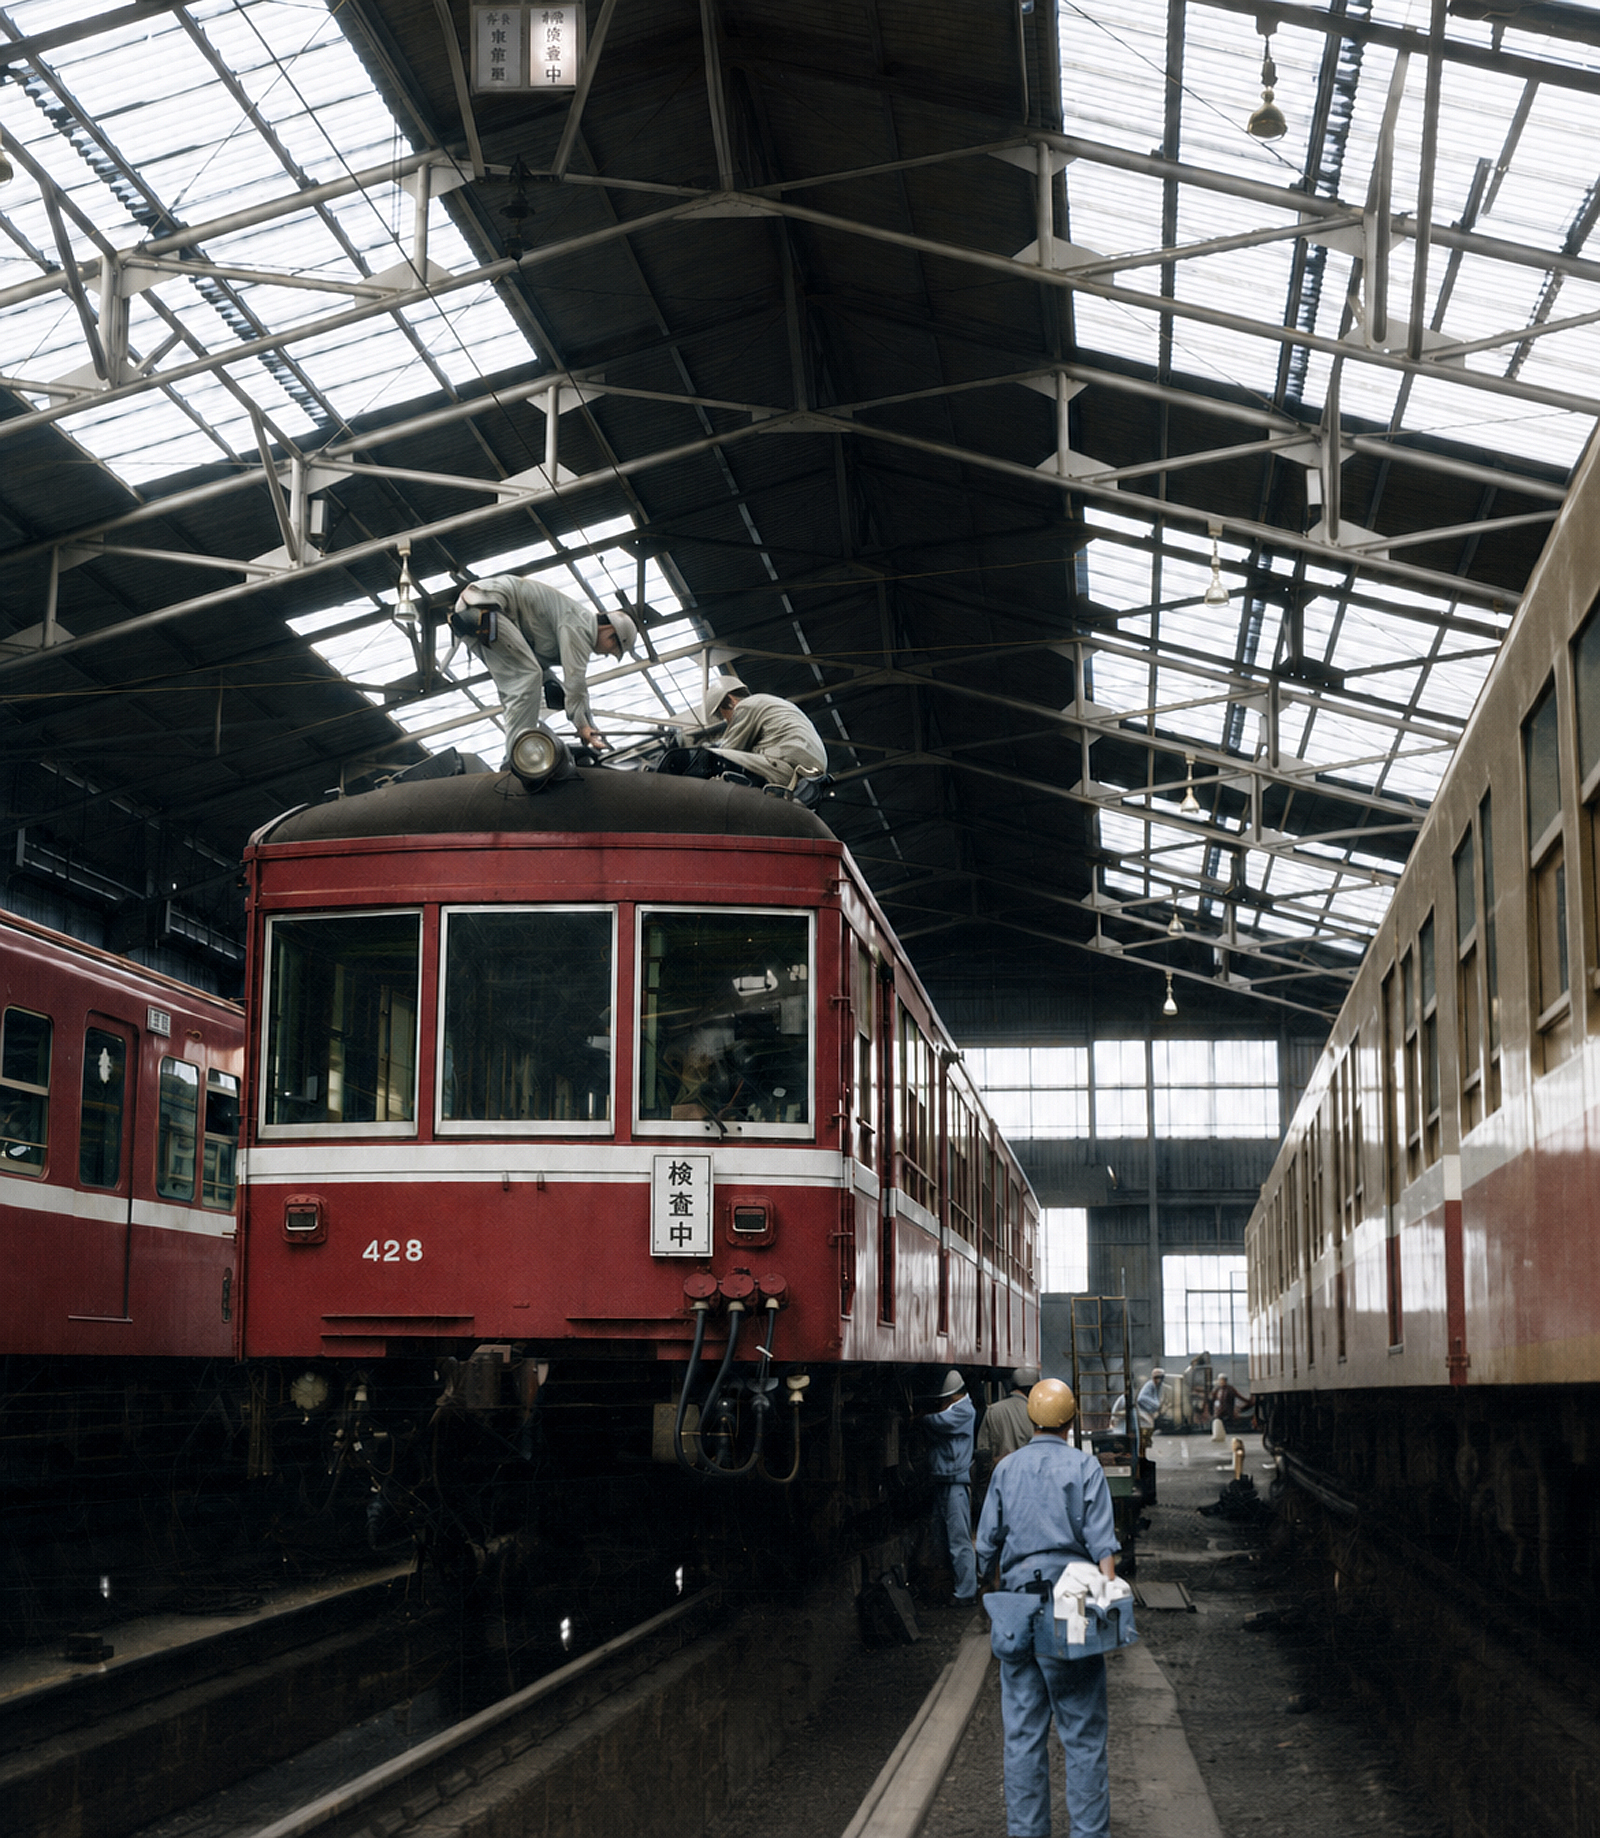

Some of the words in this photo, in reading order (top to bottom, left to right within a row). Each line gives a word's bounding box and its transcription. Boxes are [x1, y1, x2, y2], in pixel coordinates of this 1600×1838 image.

[668, 1160, 694, 1248] 検査中
[362, 1239, 423, 1262] 428
